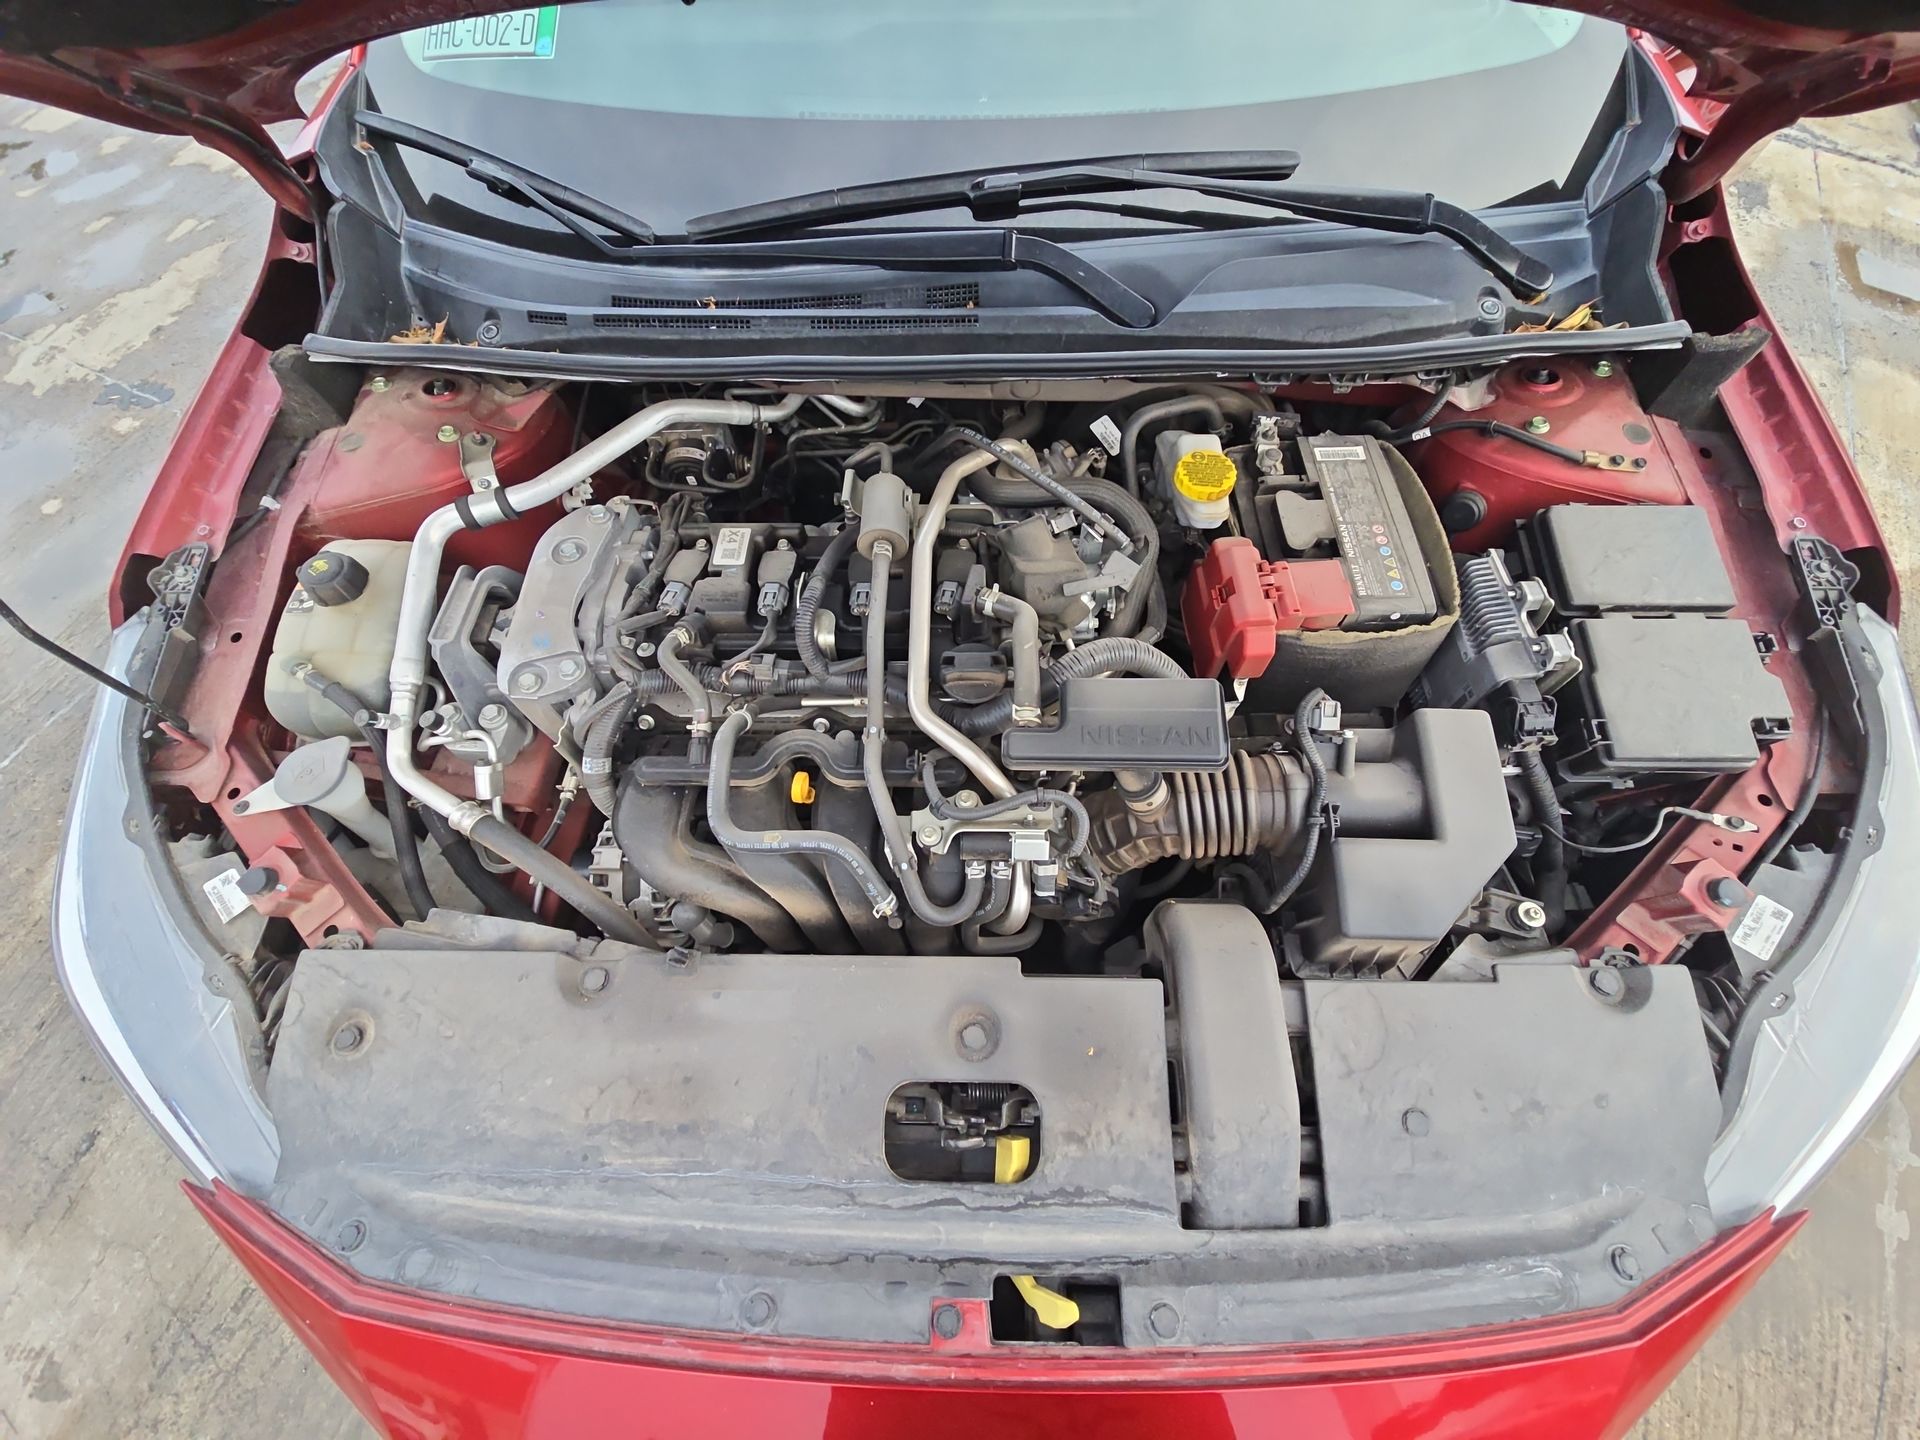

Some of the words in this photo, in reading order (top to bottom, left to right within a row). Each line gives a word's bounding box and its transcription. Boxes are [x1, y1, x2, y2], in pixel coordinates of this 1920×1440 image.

[1339, 524, 1355, 557] NISSAN
[1351, 564, 1367, 596] RENAULT
[1080, 724, 1212, 746] NISSAN
